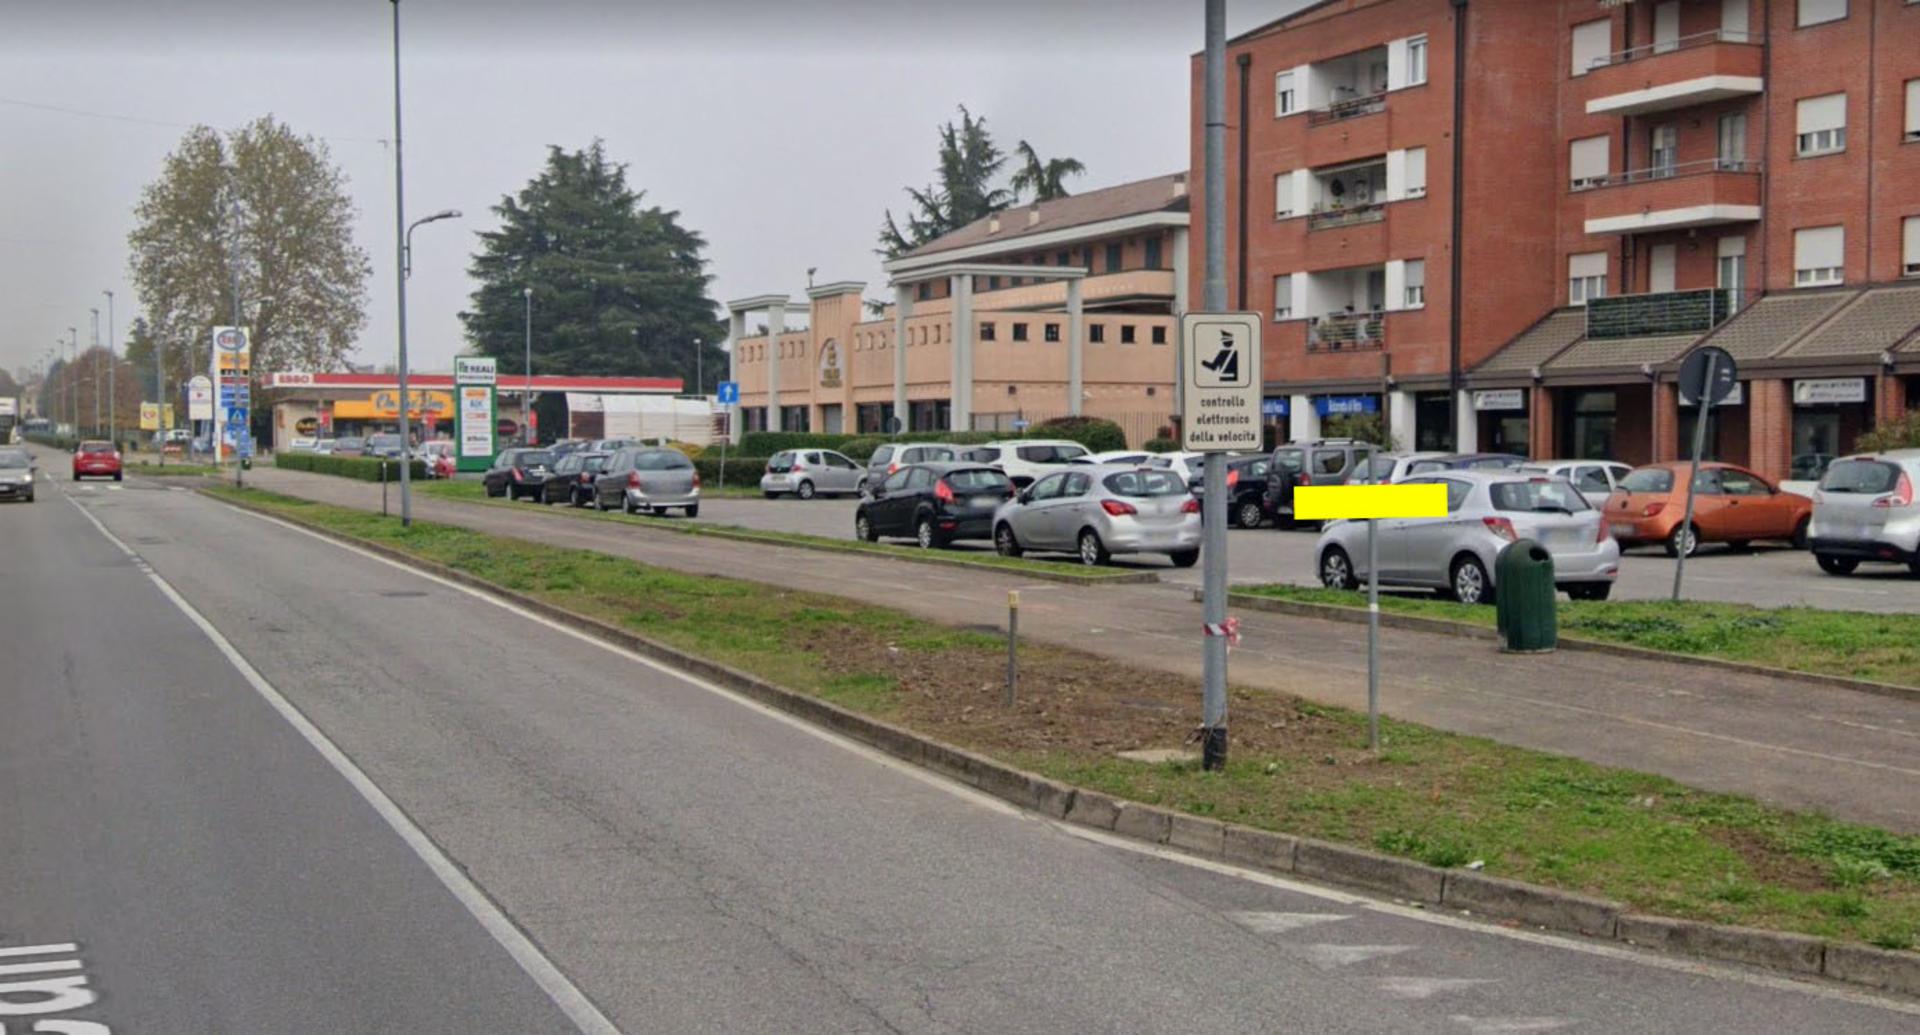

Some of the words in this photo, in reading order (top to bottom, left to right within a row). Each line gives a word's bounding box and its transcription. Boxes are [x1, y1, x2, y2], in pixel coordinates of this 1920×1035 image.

[1200, 395, 1245, 408] controllo
[1196, 413, 1250, 425] elettronico
[1189, 430, 1214, 442] della
